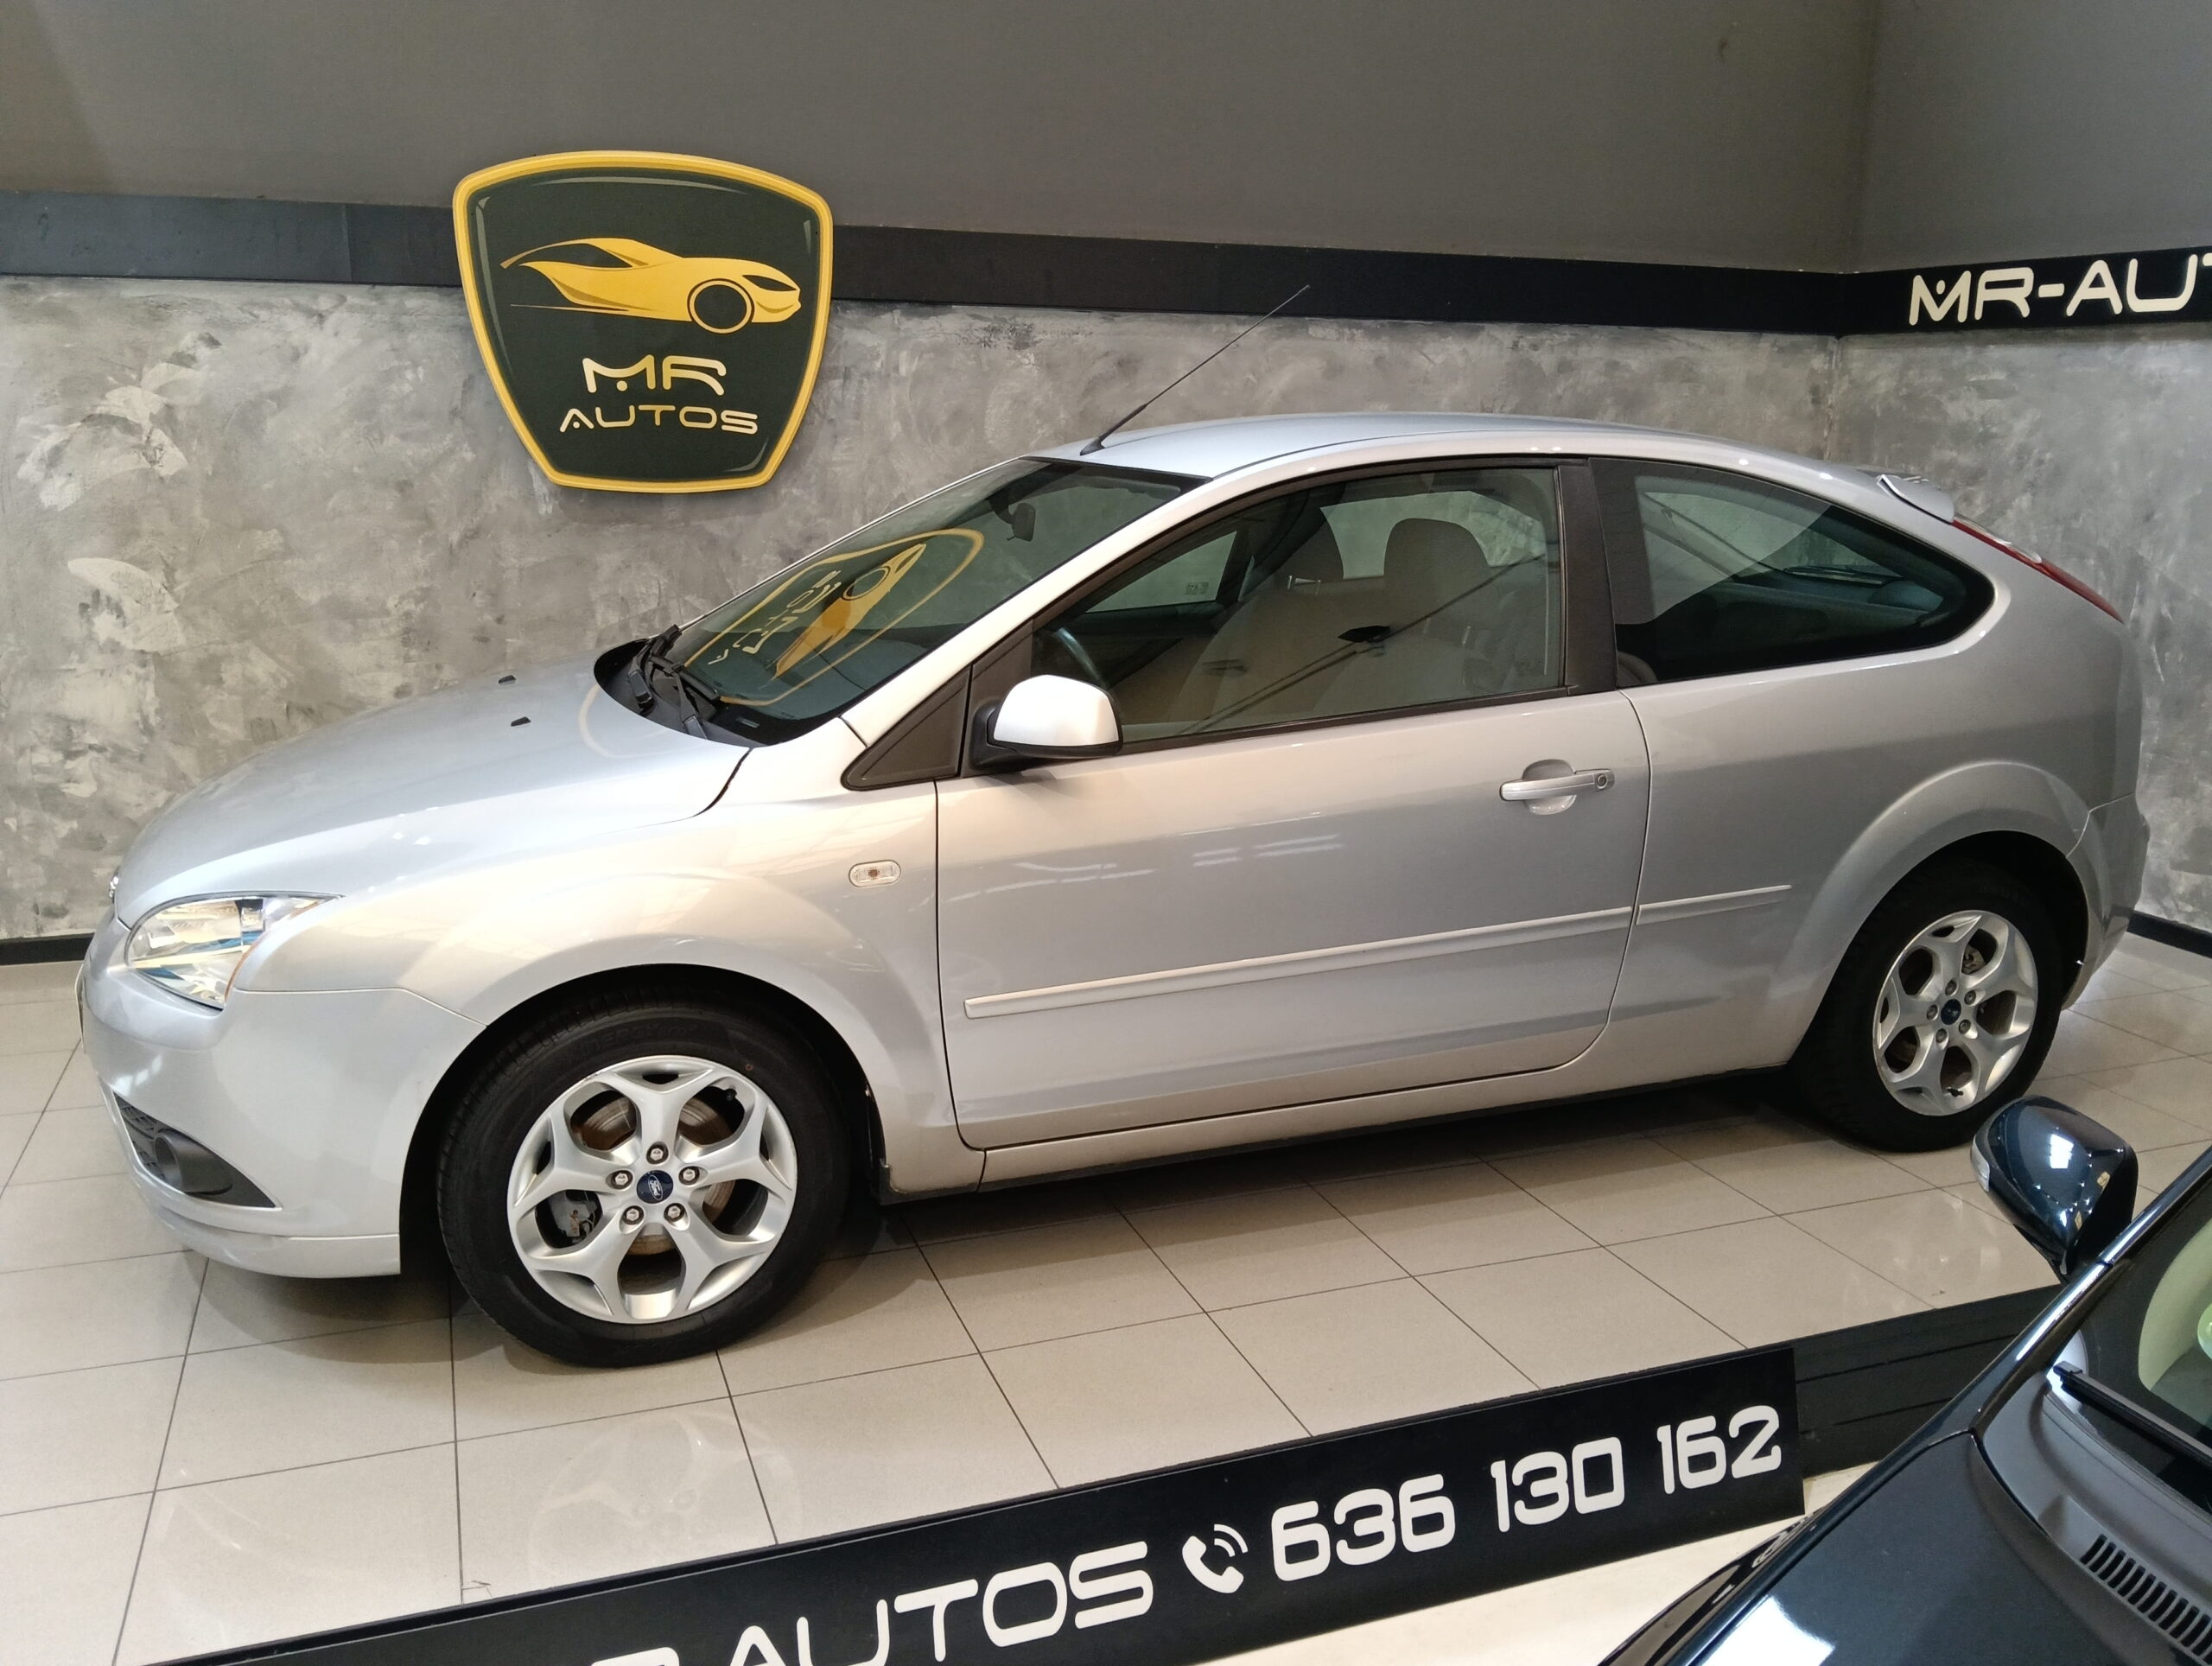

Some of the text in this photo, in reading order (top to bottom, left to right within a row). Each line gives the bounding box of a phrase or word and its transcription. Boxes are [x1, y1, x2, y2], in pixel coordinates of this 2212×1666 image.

[1910, 251, 2212, 326] MR-AU
[582, 354, 727, 396] MR
[560, 404, 759, 435] AUTOS
[1271, 1473, 1456, 1581] 636
[1491, 1437, 1625, 1533] 130
[1656, 1405, 1782, 1495] 162
